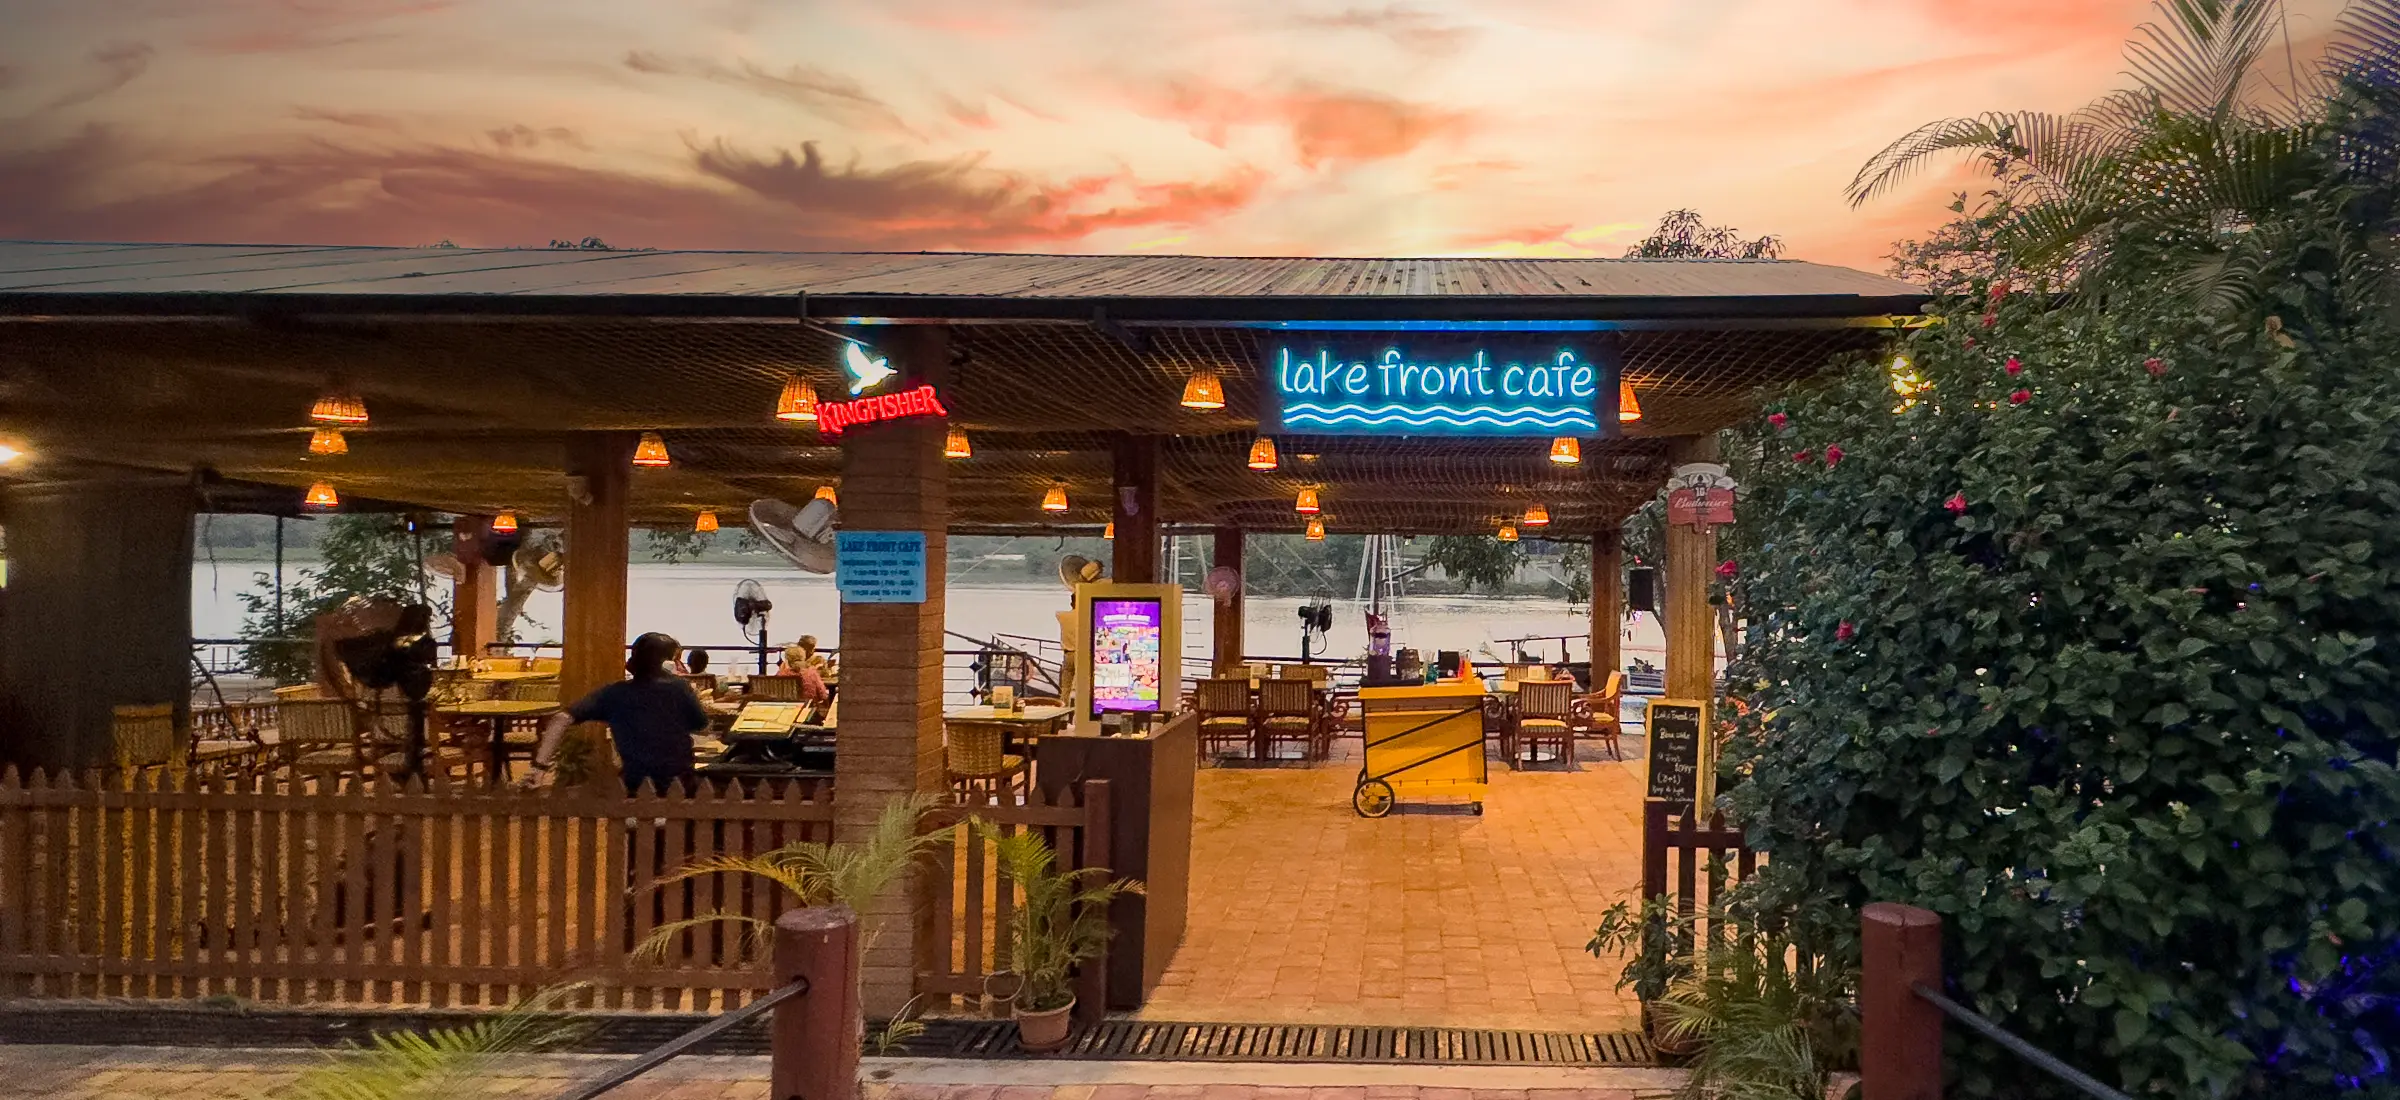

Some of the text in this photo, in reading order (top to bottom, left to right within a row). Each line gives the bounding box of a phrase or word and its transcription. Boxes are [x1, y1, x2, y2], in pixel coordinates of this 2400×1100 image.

[1281, 347, 1596, 397] lake front cafe
[815, 385, 947, 434] KINGFISHER
[1674, 497, 1729, 508] Budweiser
[842, 541, 921, 552] LAKE FRONT CAFE
